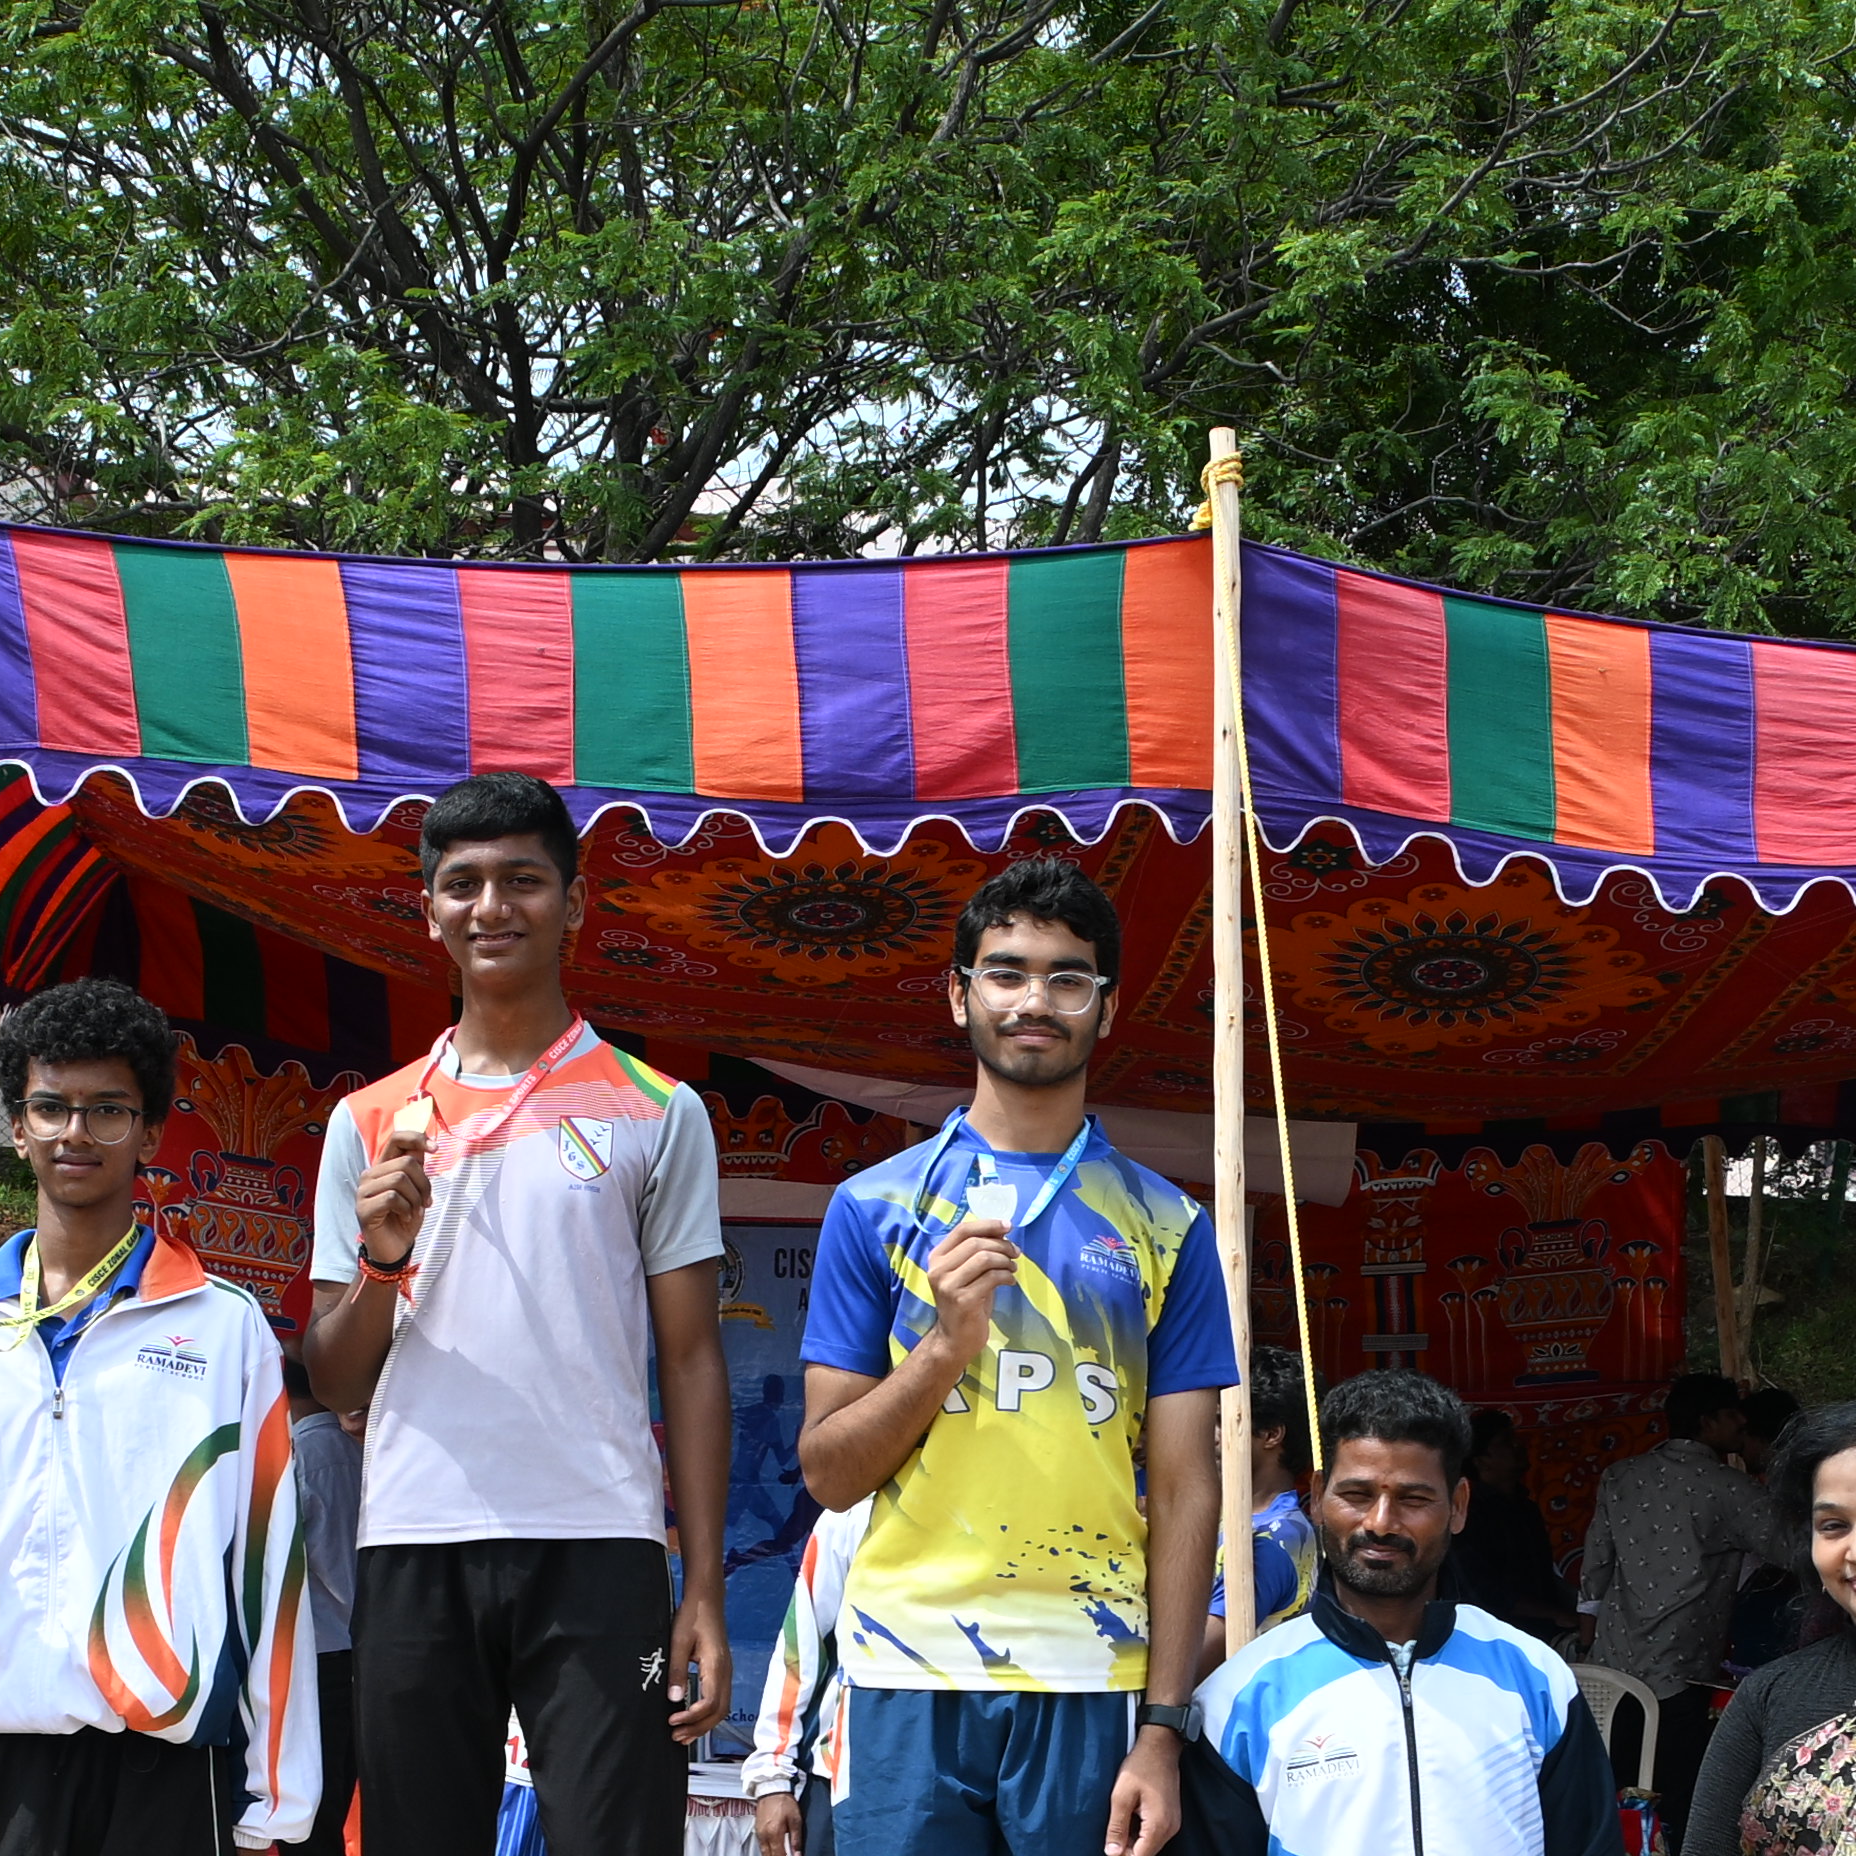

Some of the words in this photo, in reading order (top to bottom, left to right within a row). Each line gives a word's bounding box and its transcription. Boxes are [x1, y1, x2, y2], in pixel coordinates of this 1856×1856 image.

[549, 1039, 570, 1060] CISCE
[87, 1267, 111, 1288] CISCE
[108, 1246, 130, 1269] ZONAL
[774, 1247, 817, 1279] CIS
[1080, 1252, 1139, 1281] RAMADEVI
[137, 1353, 207, 1376] RAMADEVI
[1287, 1758, 1360, 1783] RAMADEVI
